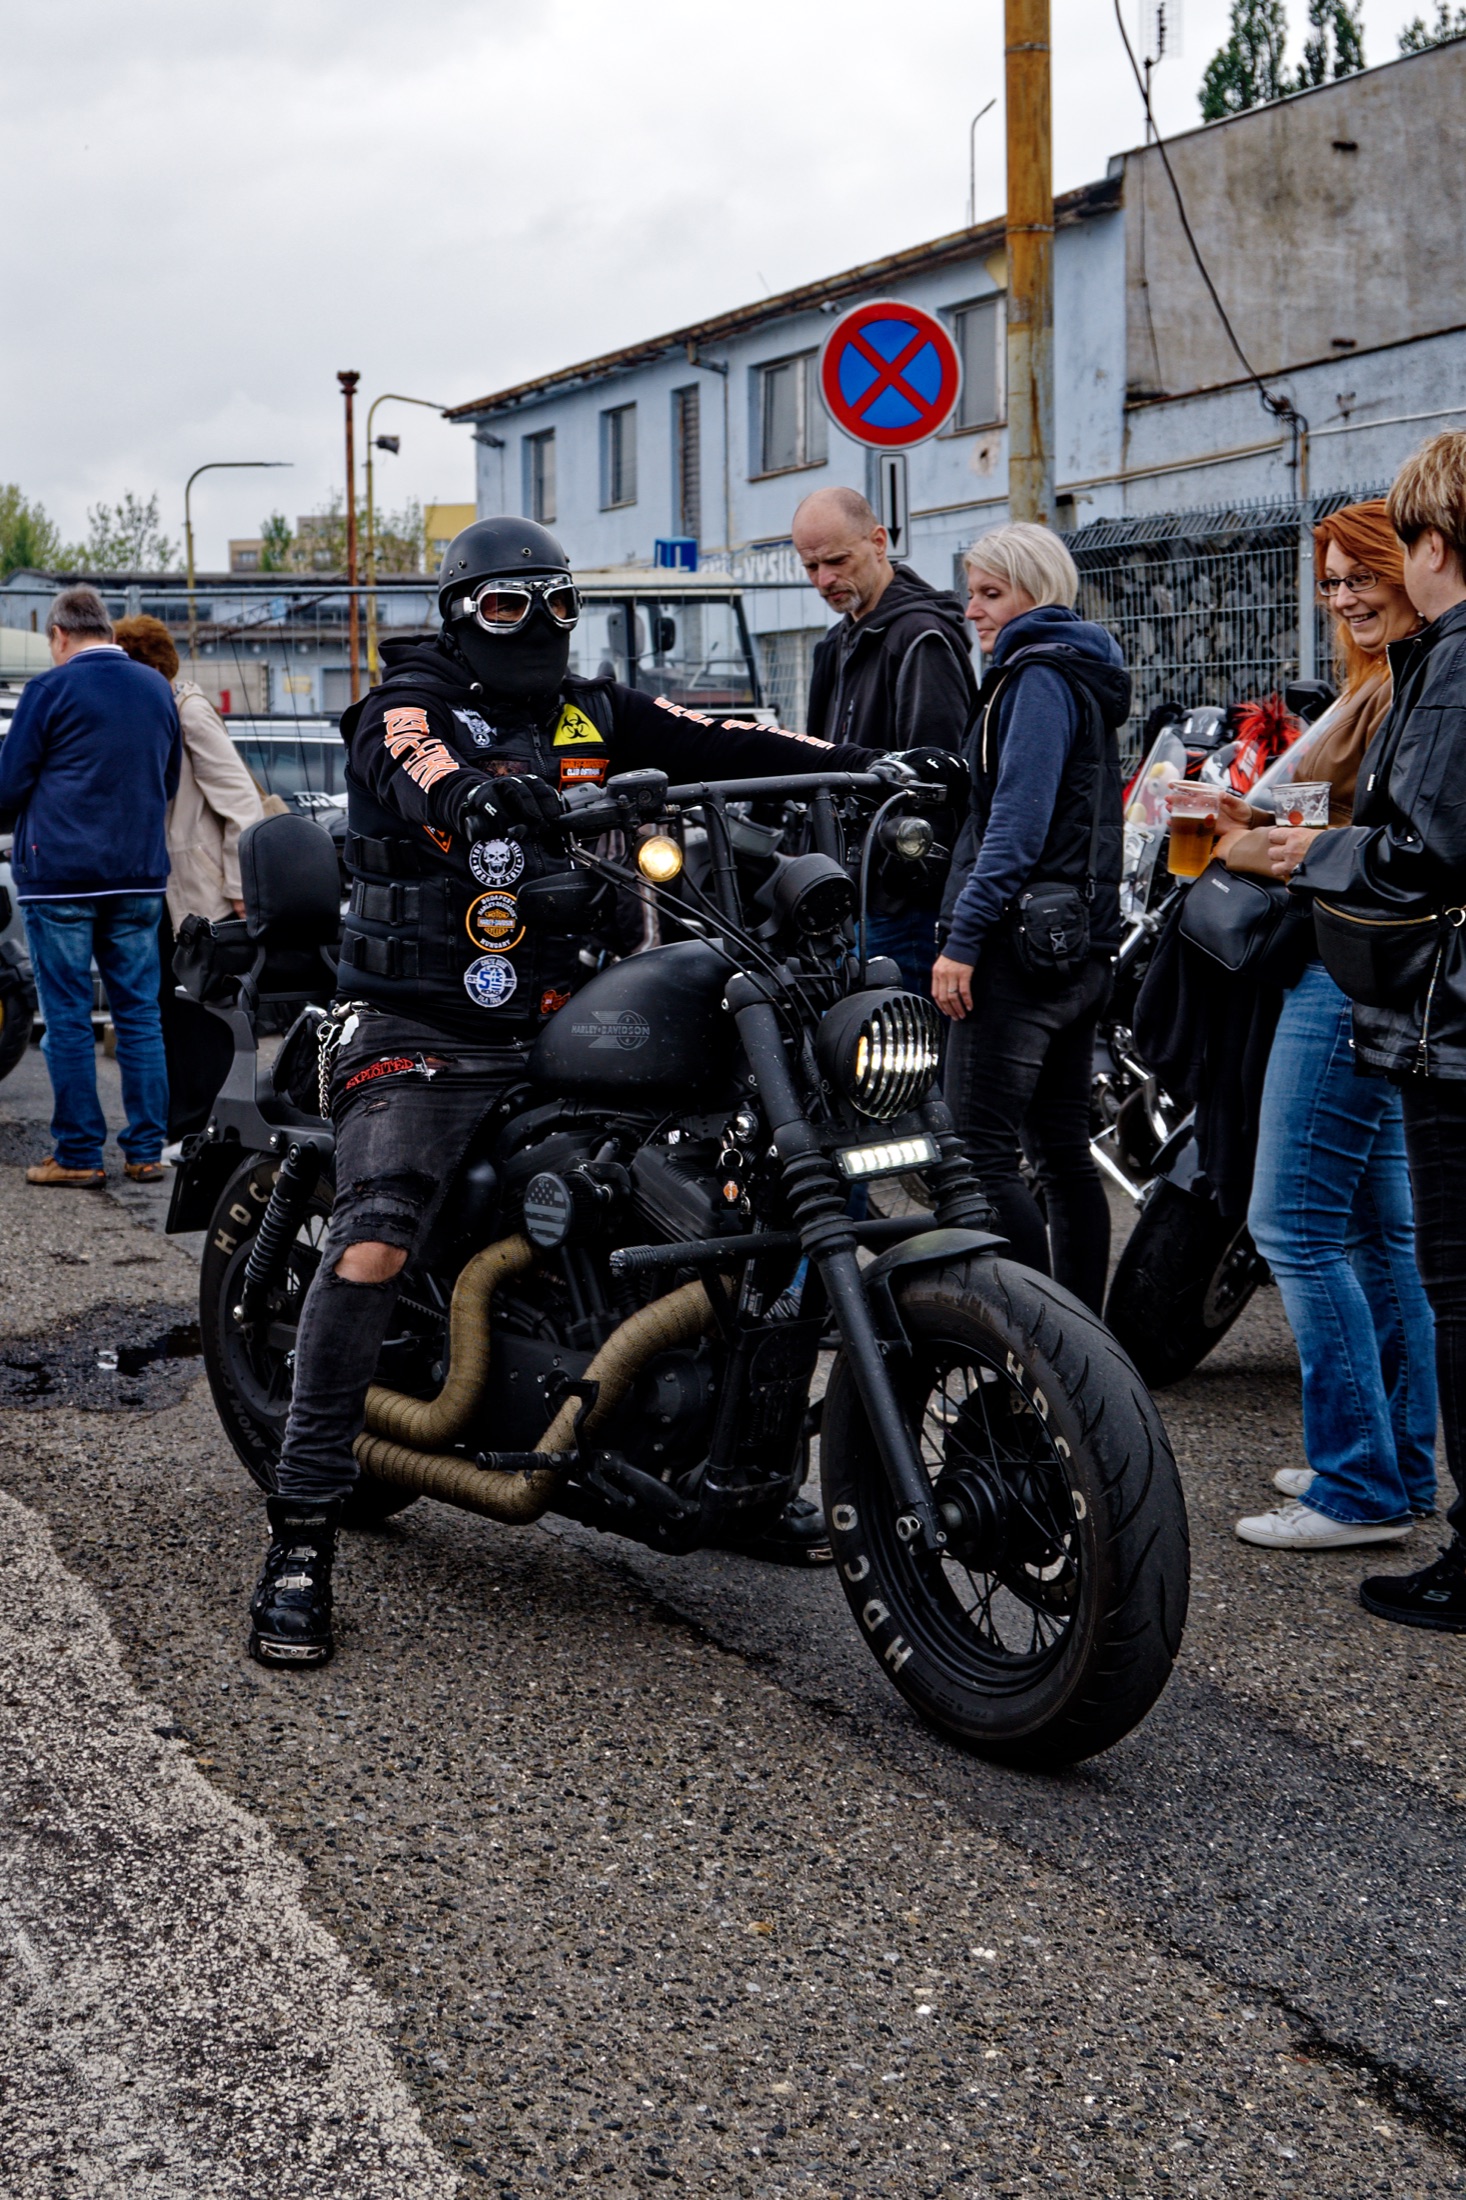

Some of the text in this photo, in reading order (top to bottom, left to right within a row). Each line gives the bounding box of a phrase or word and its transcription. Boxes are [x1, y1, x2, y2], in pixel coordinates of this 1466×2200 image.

[480, 894, 516, 906] BUDAPEST
[480, 937, 511, 949] HUNGARY
[345, 1058, 414, 1090] EXPLOITED
